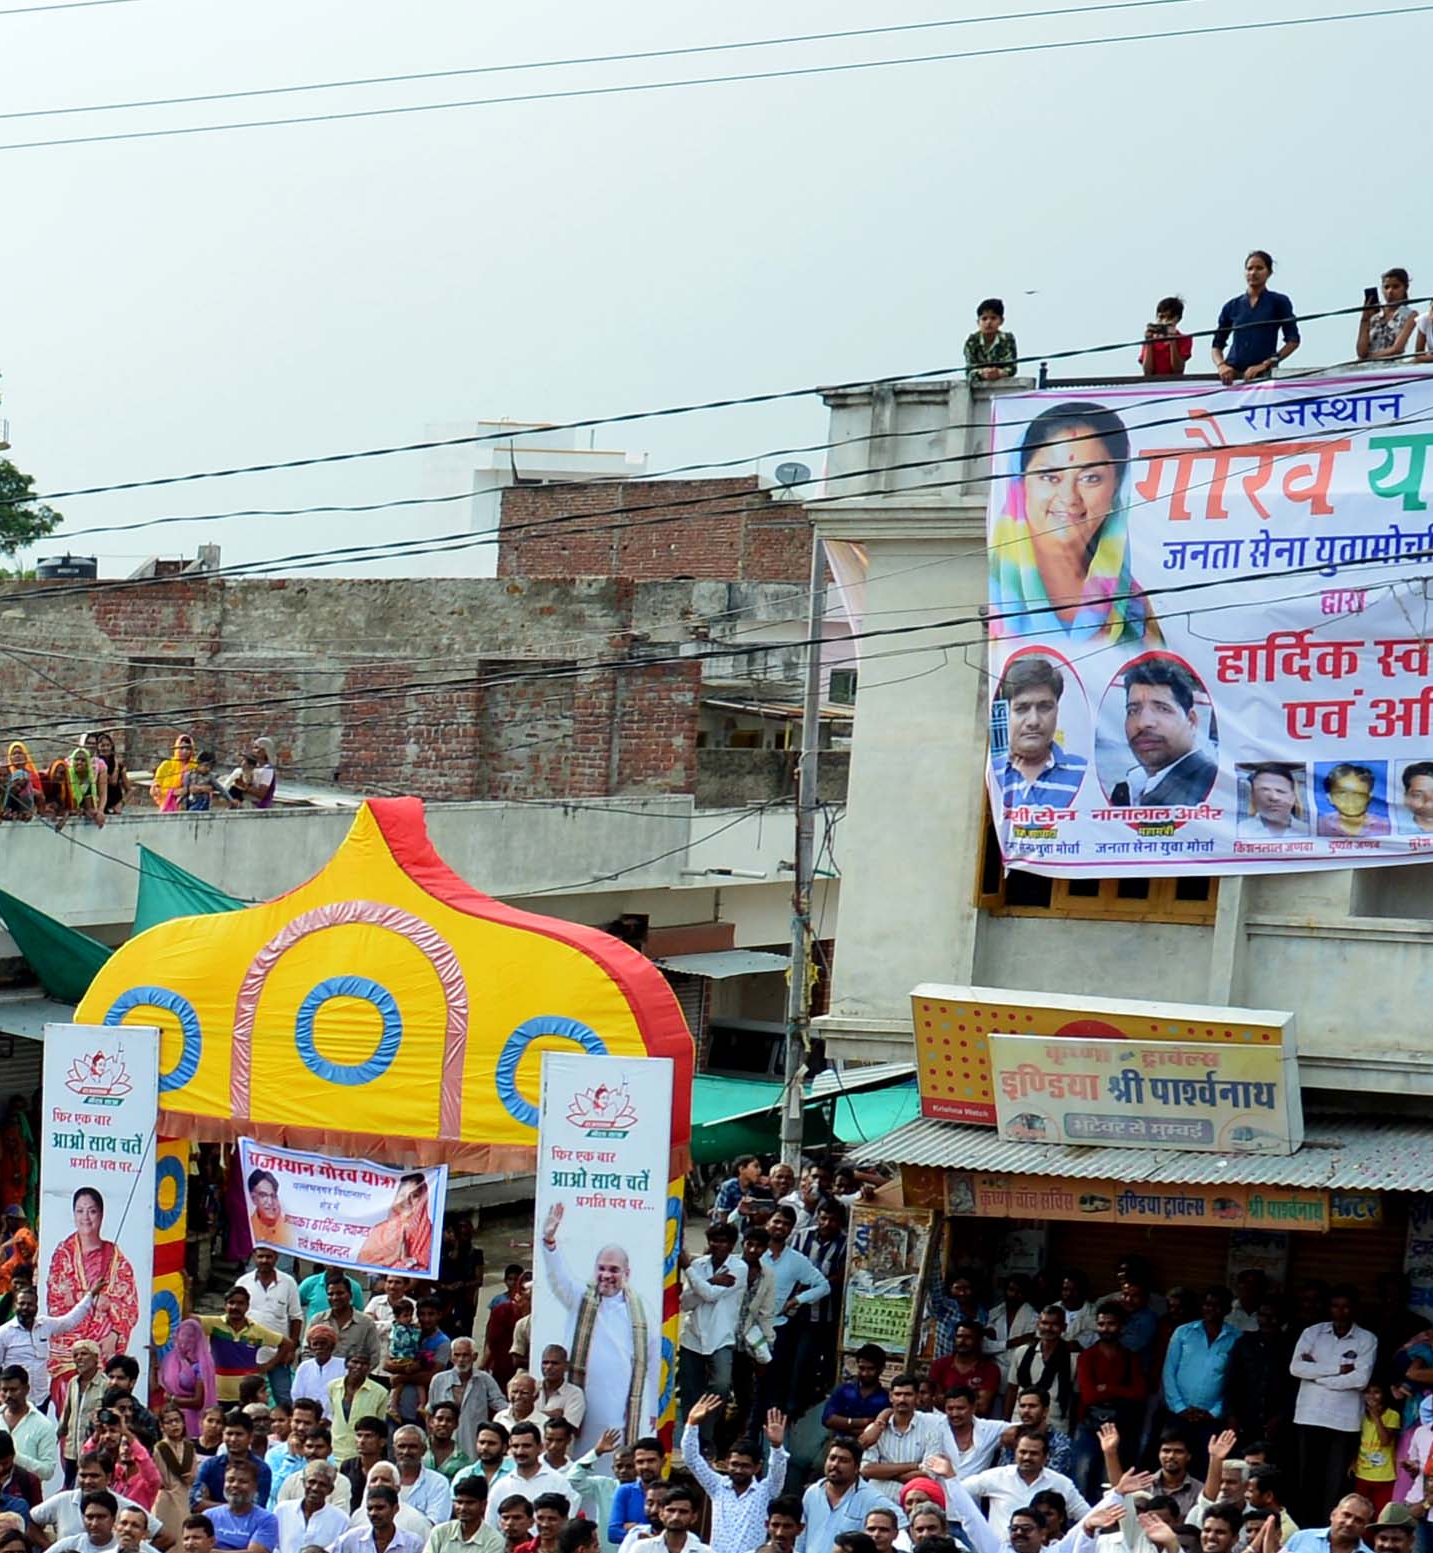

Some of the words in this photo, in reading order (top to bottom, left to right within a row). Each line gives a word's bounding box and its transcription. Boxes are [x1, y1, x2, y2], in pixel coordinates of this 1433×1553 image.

[1244, 393, 1405, 431] राजस्थान
[1134, 409, 1351, 520] गौरव
[1163, 540, 1244, 570] जनता
[1250, 529, 1309, 567] सेना
[1215, 629, 1365, 683] हार्दिक
[1283, 688, 1365, 740] एवं
[1091, 808, 1171, 822] नानालाल
[1000, 1063, 1100, 1101] इण्डिया
[1107, 1068, 1145, 1105] श्री
[1149, 1069, 1276, 1110] पार्श्वनाथ
[74, 1113, 92, 1125] एक
[52, 1129, 85, 1150] आओ
[88, 1136, 116, 1152] साथ
[70, 1155, 97, 1168] प्रगति
[247, 1151, 315, 1178] राजस्थान
[318, 1162, 360, 1183] गौरव
[576, 1150, 594, 1163] एक
[551, 1167, 587, 1188] आओ
[591, 1172, 622, 1190] साथ
[576, 1193, 606, 1208] प्रगति
[1117, 1192, 1160, 1217] इण्डिया
